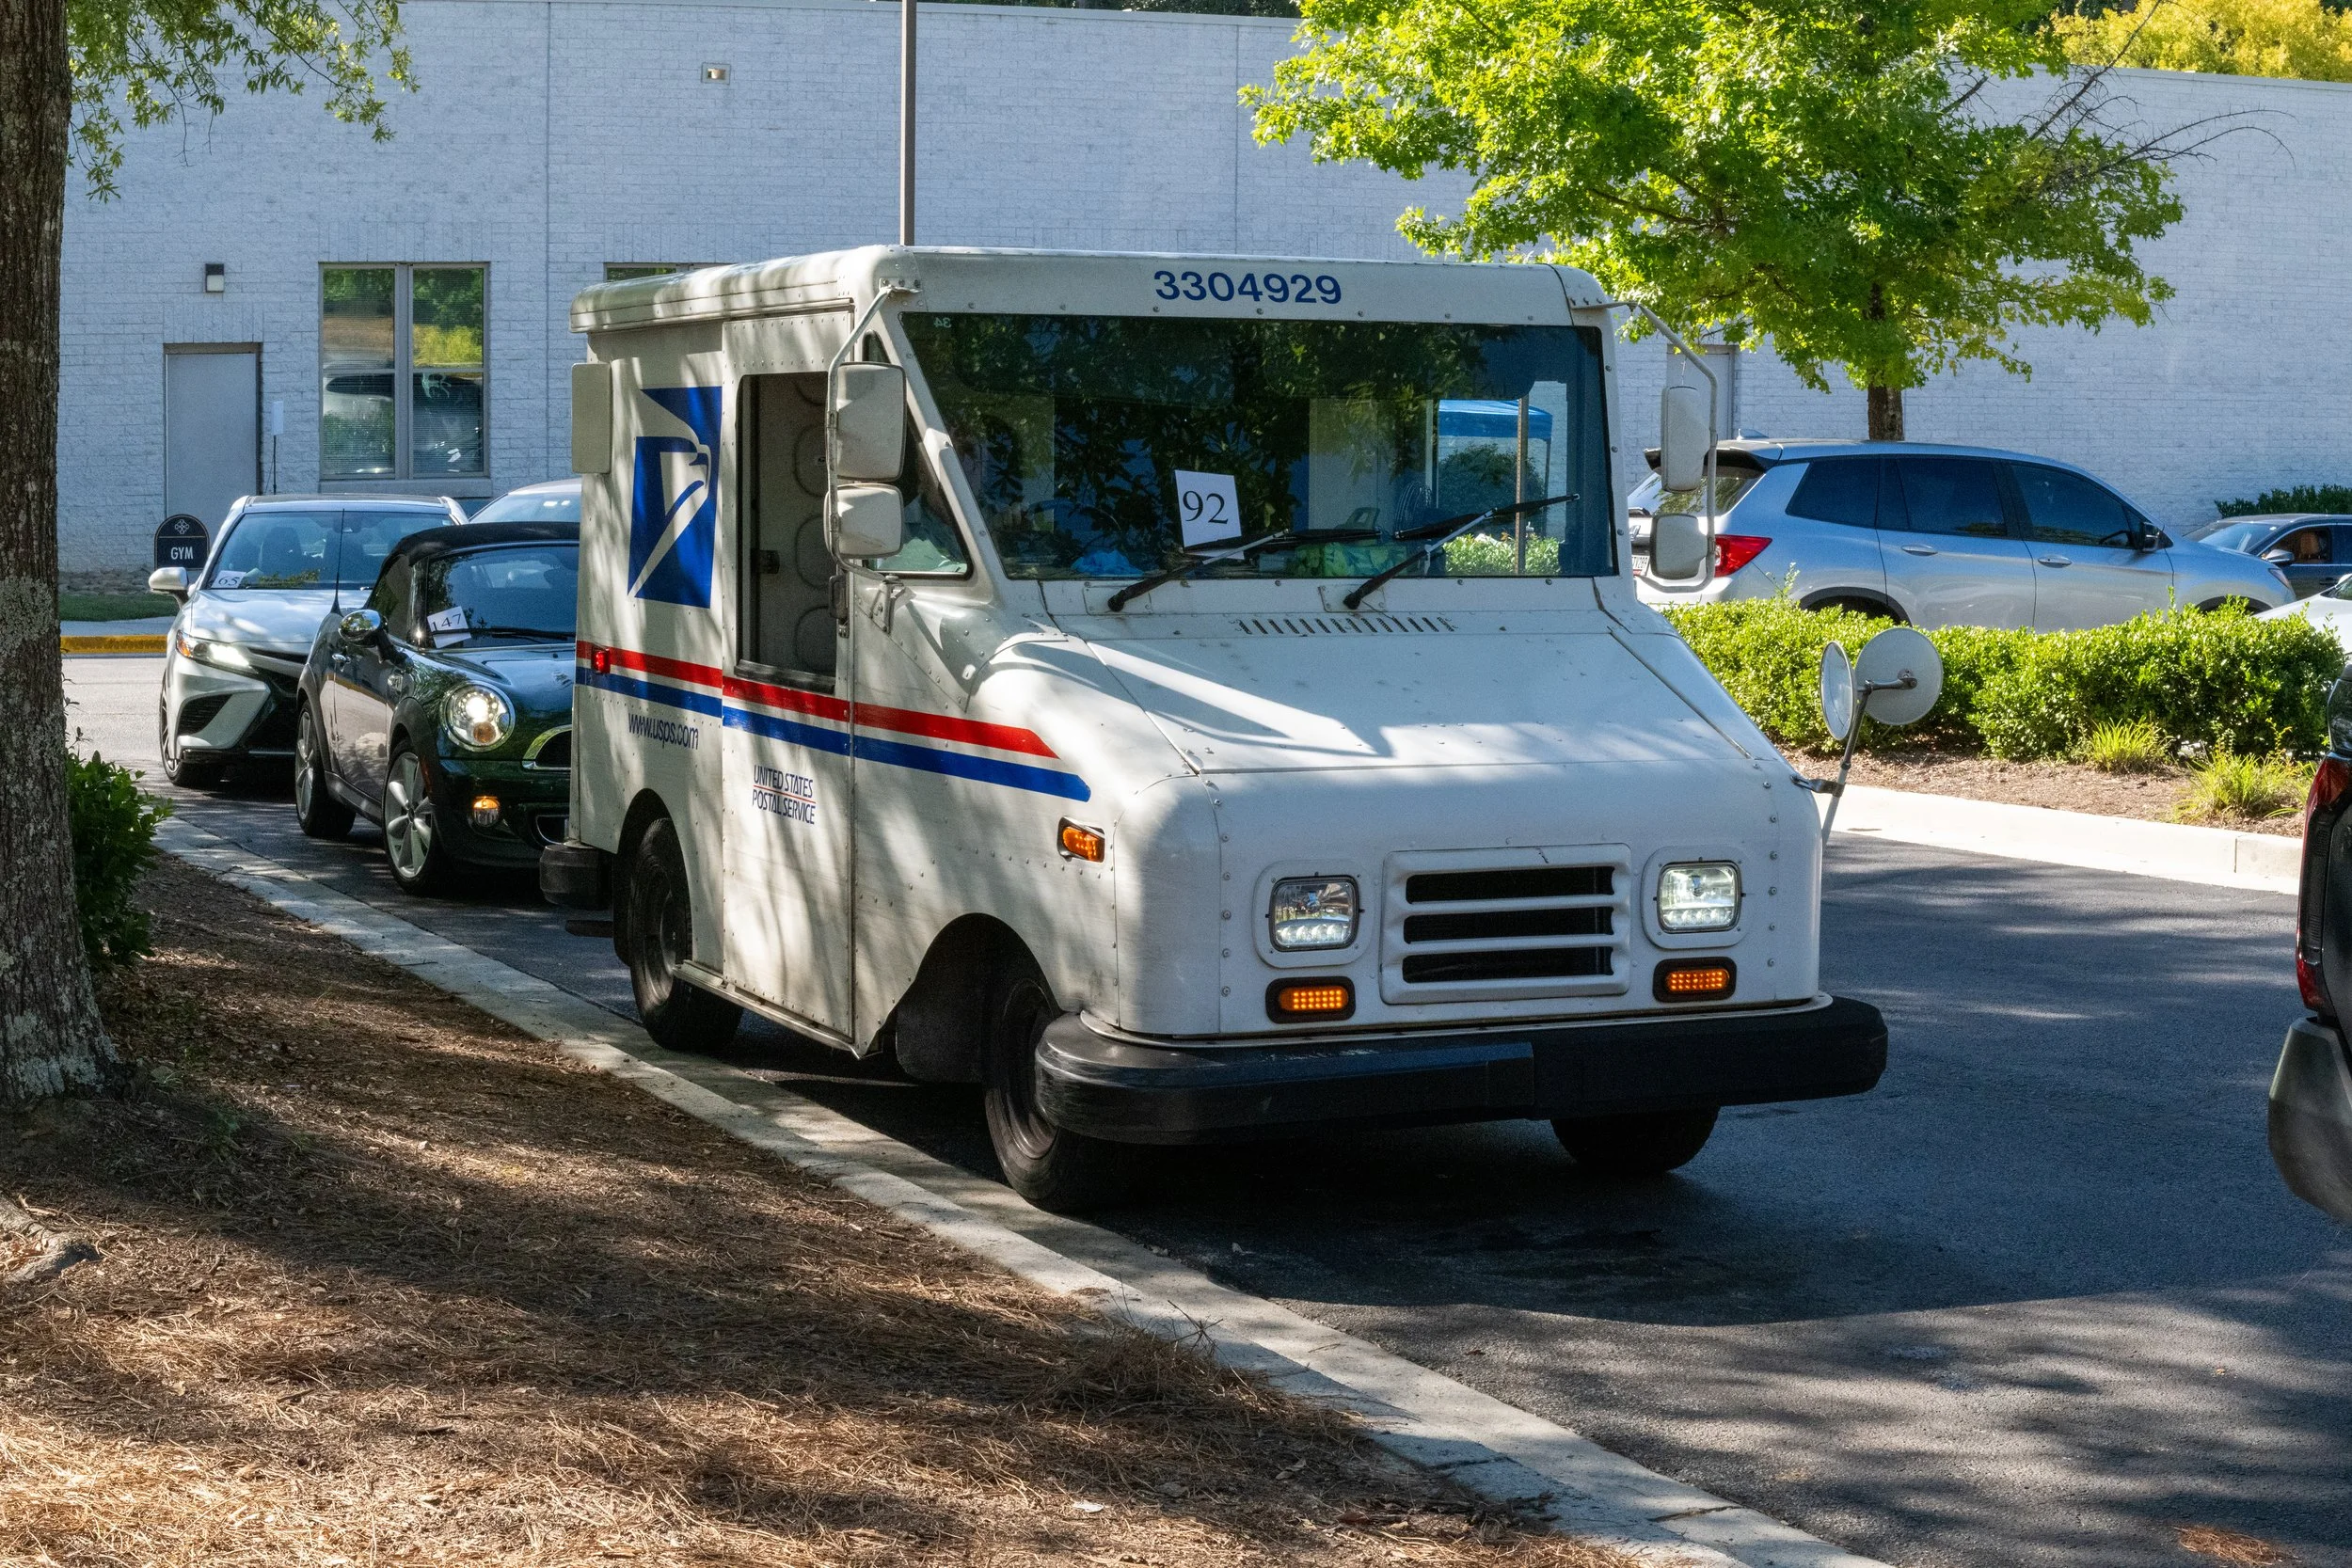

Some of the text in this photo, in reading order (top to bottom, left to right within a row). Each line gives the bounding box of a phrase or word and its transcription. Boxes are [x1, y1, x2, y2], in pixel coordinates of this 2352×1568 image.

[1153, 270, 1342, 305] 3304929
[1183, 490, 1229, 525] 92
[170, 546, 194, 560] GYM
[218, 577, 240, 586] 65
[432, 613, 461, 631] 147
[628, 712, 699, 750] www.usps.com
[754, 765, 814, 799] UNITED STATES
[752, 788, 817, 825] POSTAL SERVICE
